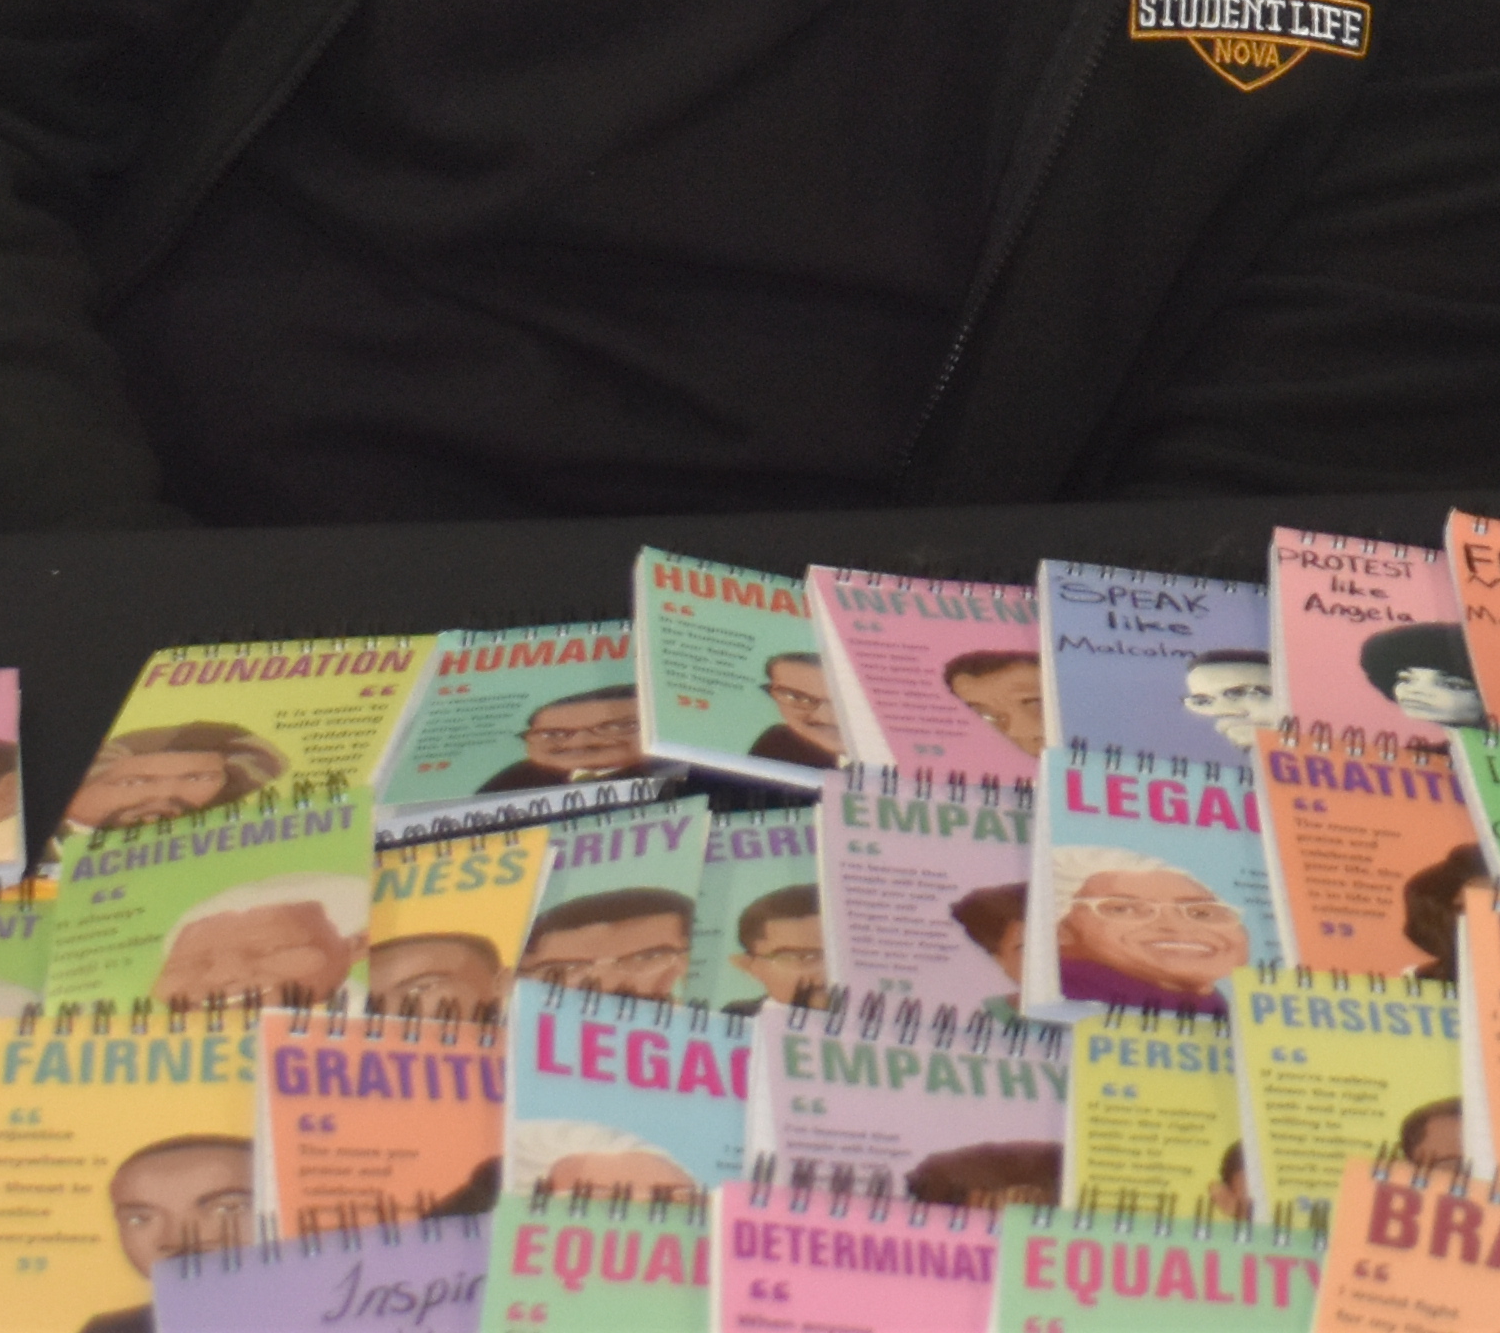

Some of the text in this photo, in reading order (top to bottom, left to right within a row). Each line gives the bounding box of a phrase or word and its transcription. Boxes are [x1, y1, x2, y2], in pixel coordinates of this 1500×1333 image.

[1290, 0, 1362, 47] LIFE
[1214, 38, 1280, 68] NOVA
[1277, 545, 1414, 580] PROTEST
[653, 562, 814, 619] HUMA
[1058, 579, 1211, 615] SPEAK
[1329, 575, 1390, 600] like
[1106, 610, 1193, 636] like
[1303, 592, 1415, 624] Angela
[437, 633, 632, 679] HUMAN
[1057, 634, 1200, 661] Malcolm
[144, 649, 414, 689] FOUNDATION
[70, 804, 358, 883] ACHIEVEMENT
[373, 846, 530, 903] NESS
[783, 1035, 1069, 1104] EMPATHY
